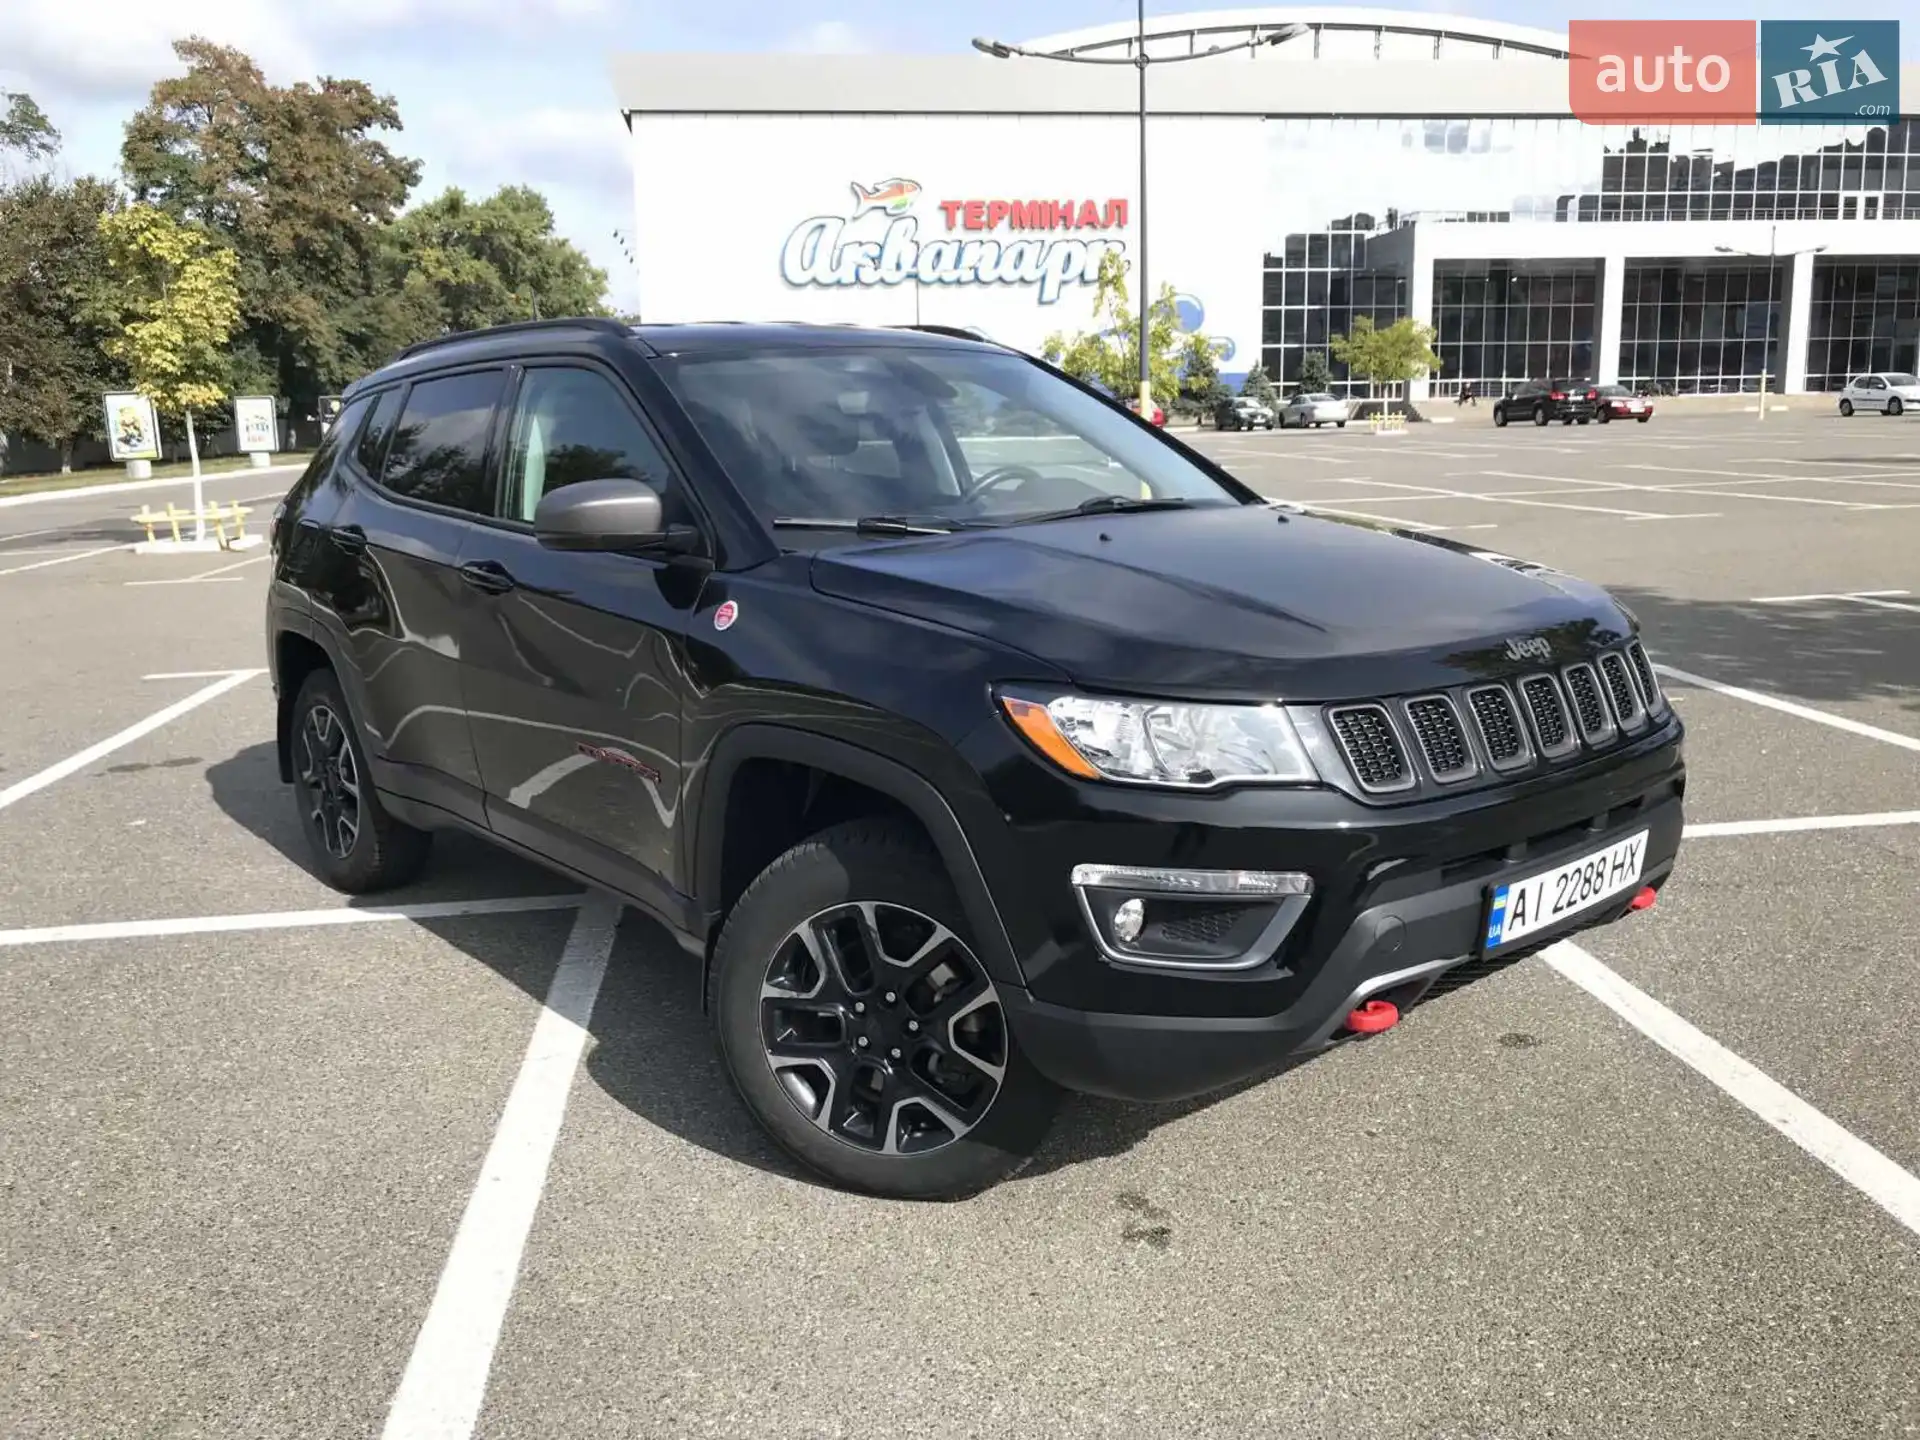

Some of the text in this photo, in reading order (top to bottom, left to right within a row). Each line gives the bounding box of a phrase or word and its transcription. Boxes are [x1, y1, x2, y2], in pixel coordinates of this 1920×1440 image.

[939, 198, 1129, 230] ТЕРМІНАЛ
[1505, 636, 1551, 661] Jeep
[1508, 838, 1643, 932] AI 2288 HX
[1487, 922, 1501, 938] UA
